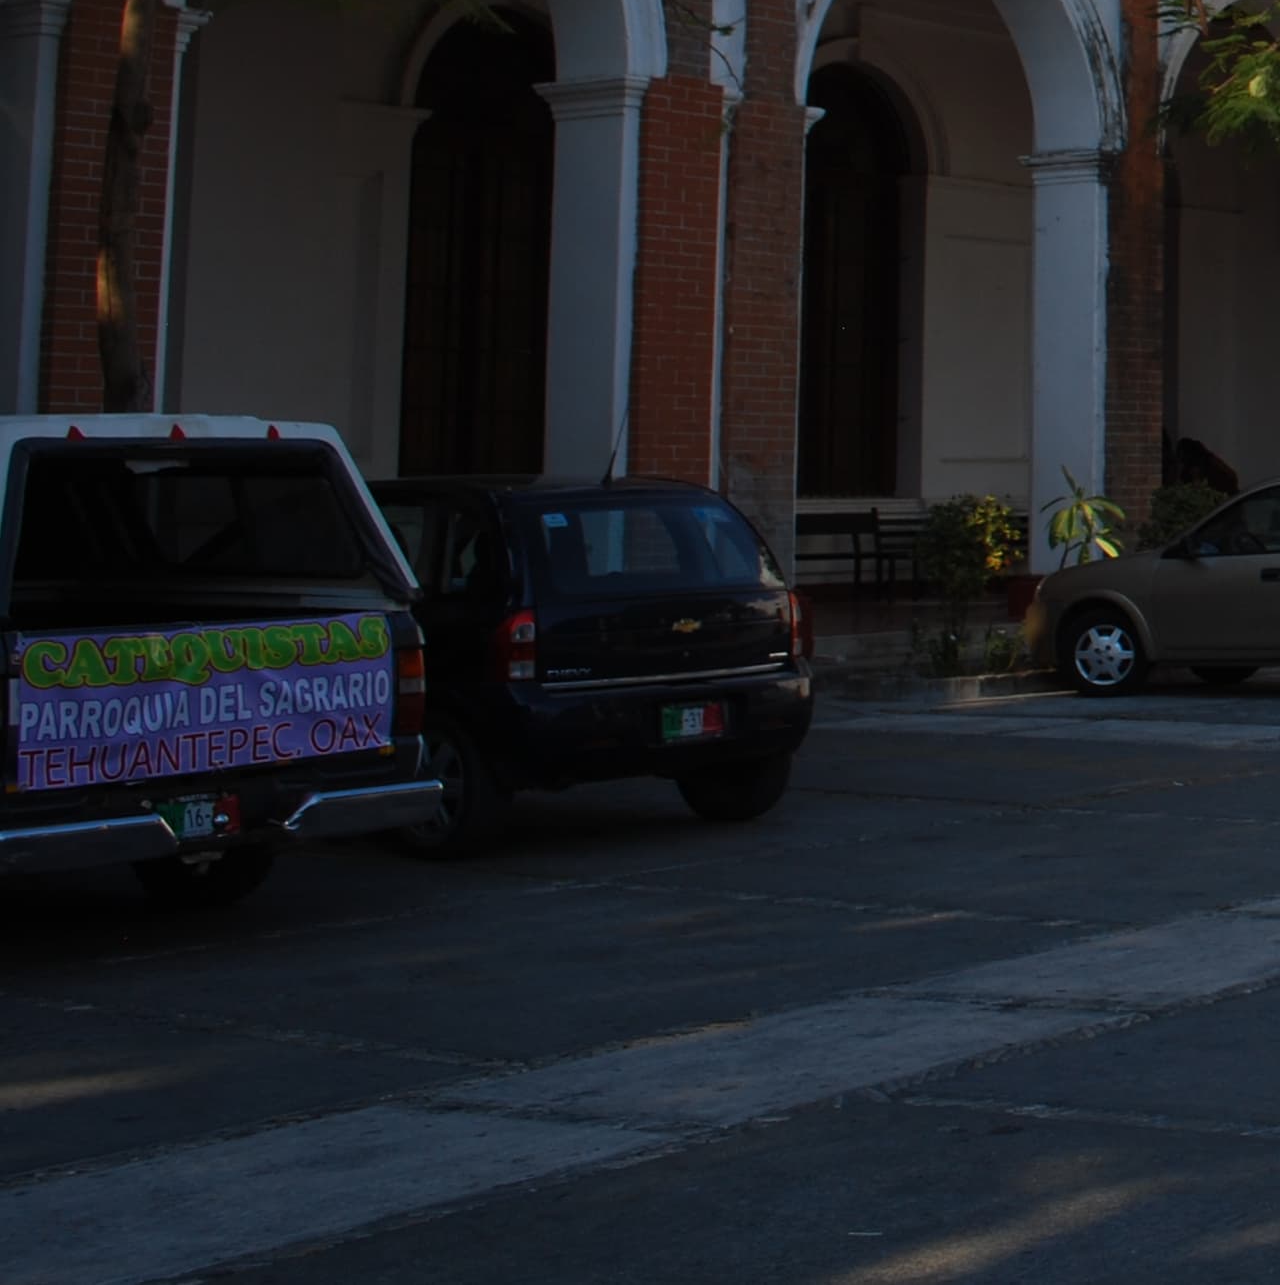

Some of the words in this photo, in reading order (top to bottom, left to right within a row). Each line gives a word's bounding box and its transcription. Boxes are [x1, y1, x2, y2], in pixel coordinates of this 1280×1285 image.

[20, 614, 390, 689] CATEQUISTAS
[19, 691, 191, 742] PARROQUIA
[199, 682, 253, 725] DEL
[258, 668, 391, 716] SAGRARIO
